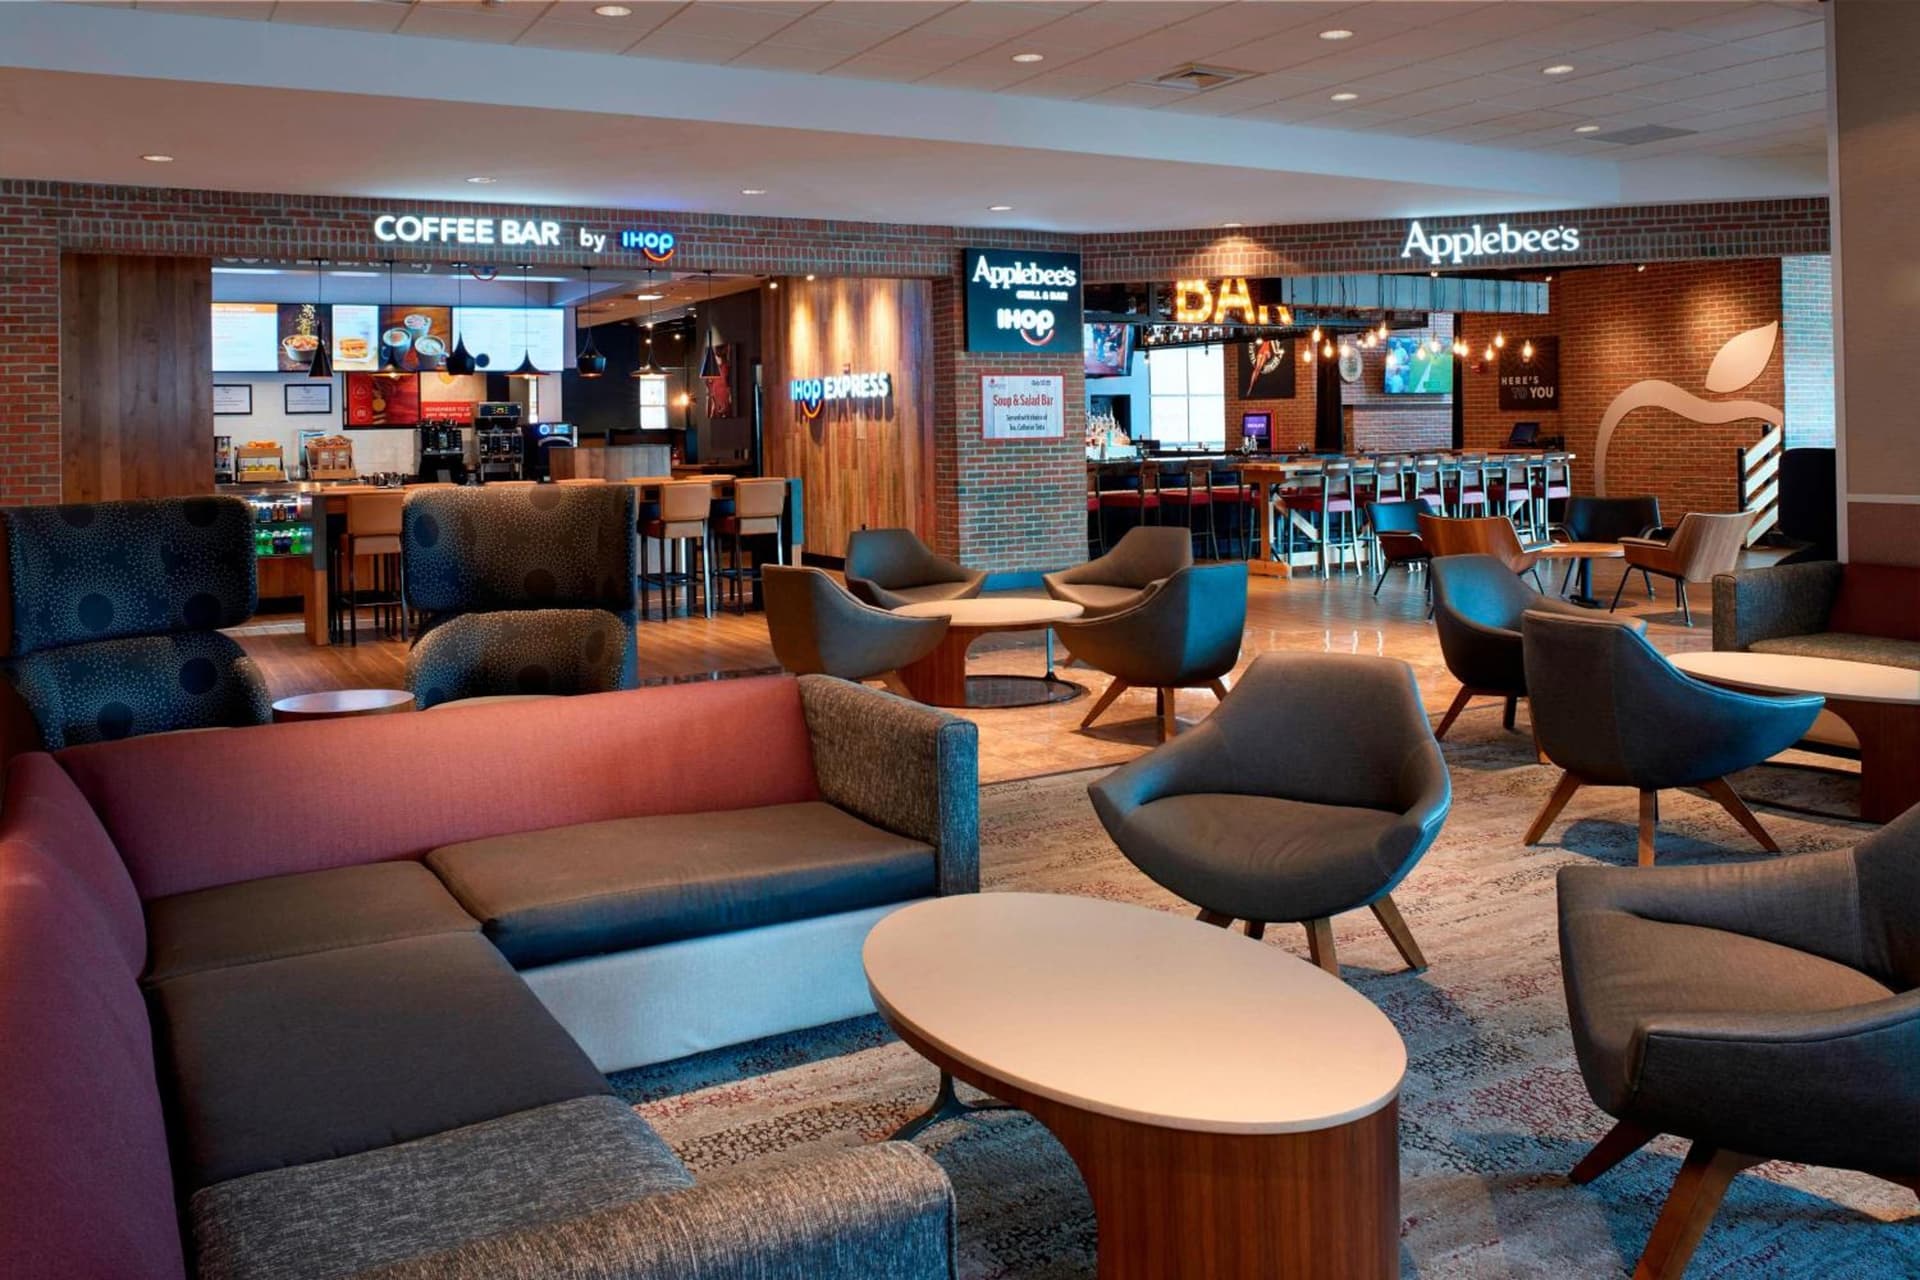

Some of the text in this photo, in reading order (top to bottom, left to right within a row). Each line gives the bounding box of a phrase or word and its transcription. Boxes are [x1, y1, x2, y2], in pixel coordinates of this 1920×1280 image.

[374, 215, 674, 253] COFFEE BAR by IHOP
[1401, 220, 1580, 265] Applebee's
[972, 255, 1077, 290] Applebee's
[996, 307, 1055, 336] IHOP
[791, 372, 888, 407] IHOP EXPRESS
[1501, 376, 1540, 385] HERE'S
[1530, 386, 1554, 399] YOU
[993, 393, 1053, 408] Soup & Salad Bar
